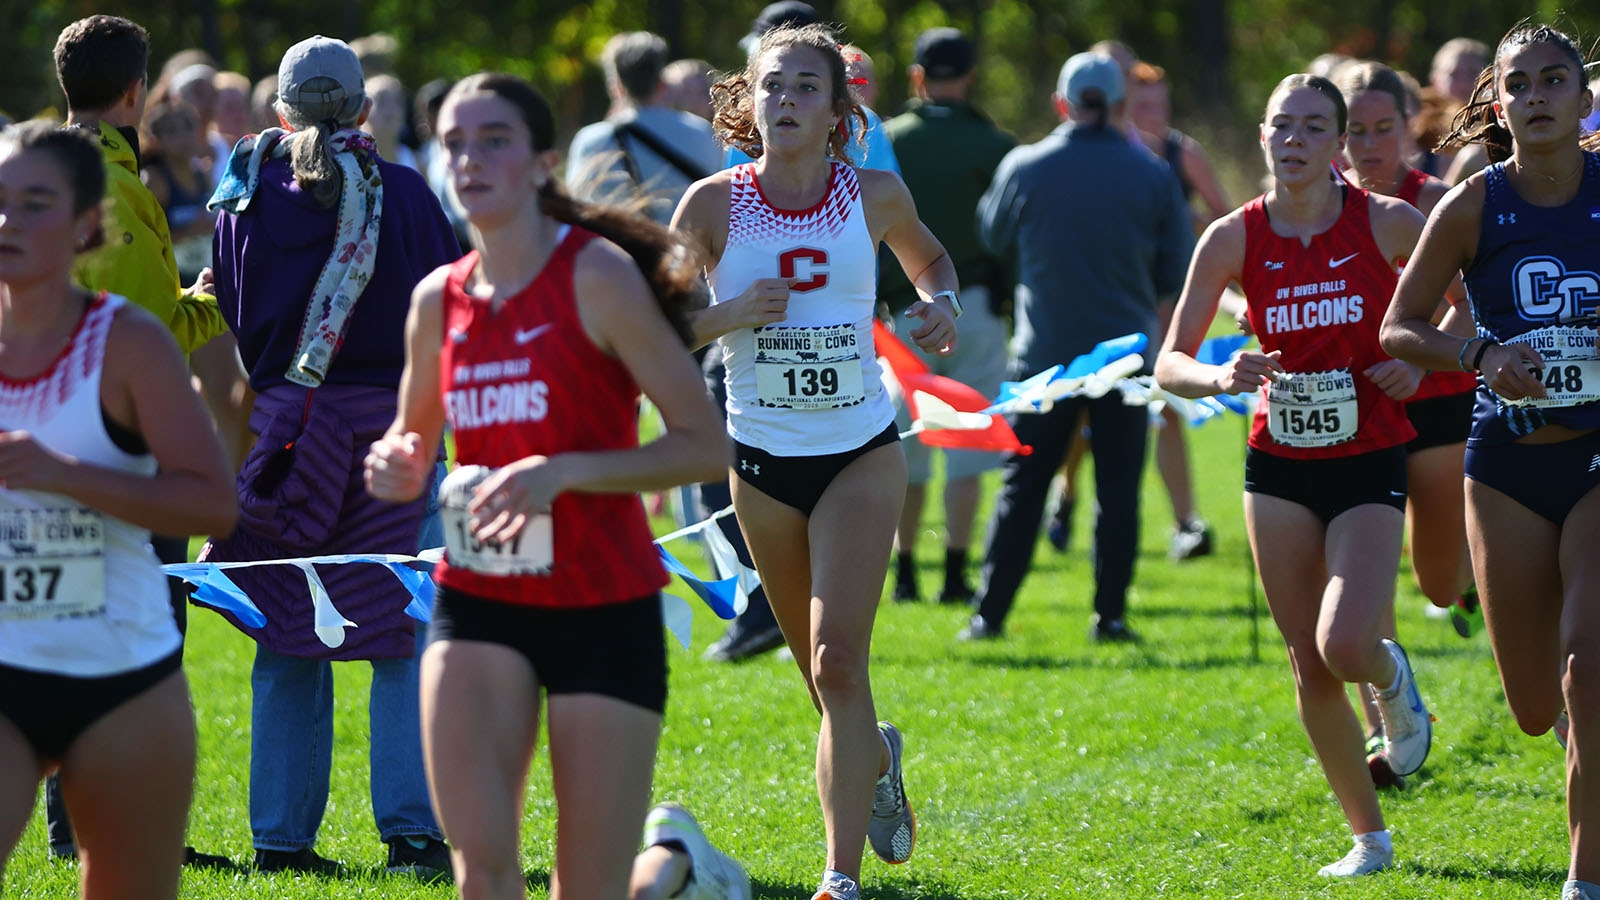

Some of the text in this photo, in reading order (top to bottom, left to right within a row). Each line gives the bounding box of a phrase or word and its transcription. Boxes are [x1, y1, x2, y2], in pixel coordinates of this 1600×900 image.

[776, 244, 830, 295] C
[1320, 279, 1346, 293] FALLS
[1265, 294, 1364, 335] FALCONS
[758, 337, 811, 350] RUNNING
[825, 333, 856, 350] COWS
[814, 329, 840, 338] COLLEGE
[1520, 329, 1554, 340] CARLETON
[1568, 336, 1599, 348] COW
[783, 367, 839, 397] 139
[1317, 377, 1353, 393] COWS
[444, 379, 549, 432] FALCONS
[814, 395, 851, 403] CHAMPIONSHIP
[1279, 407, 1341, 435] 1545
[47, 523, 100, 540] COWS
